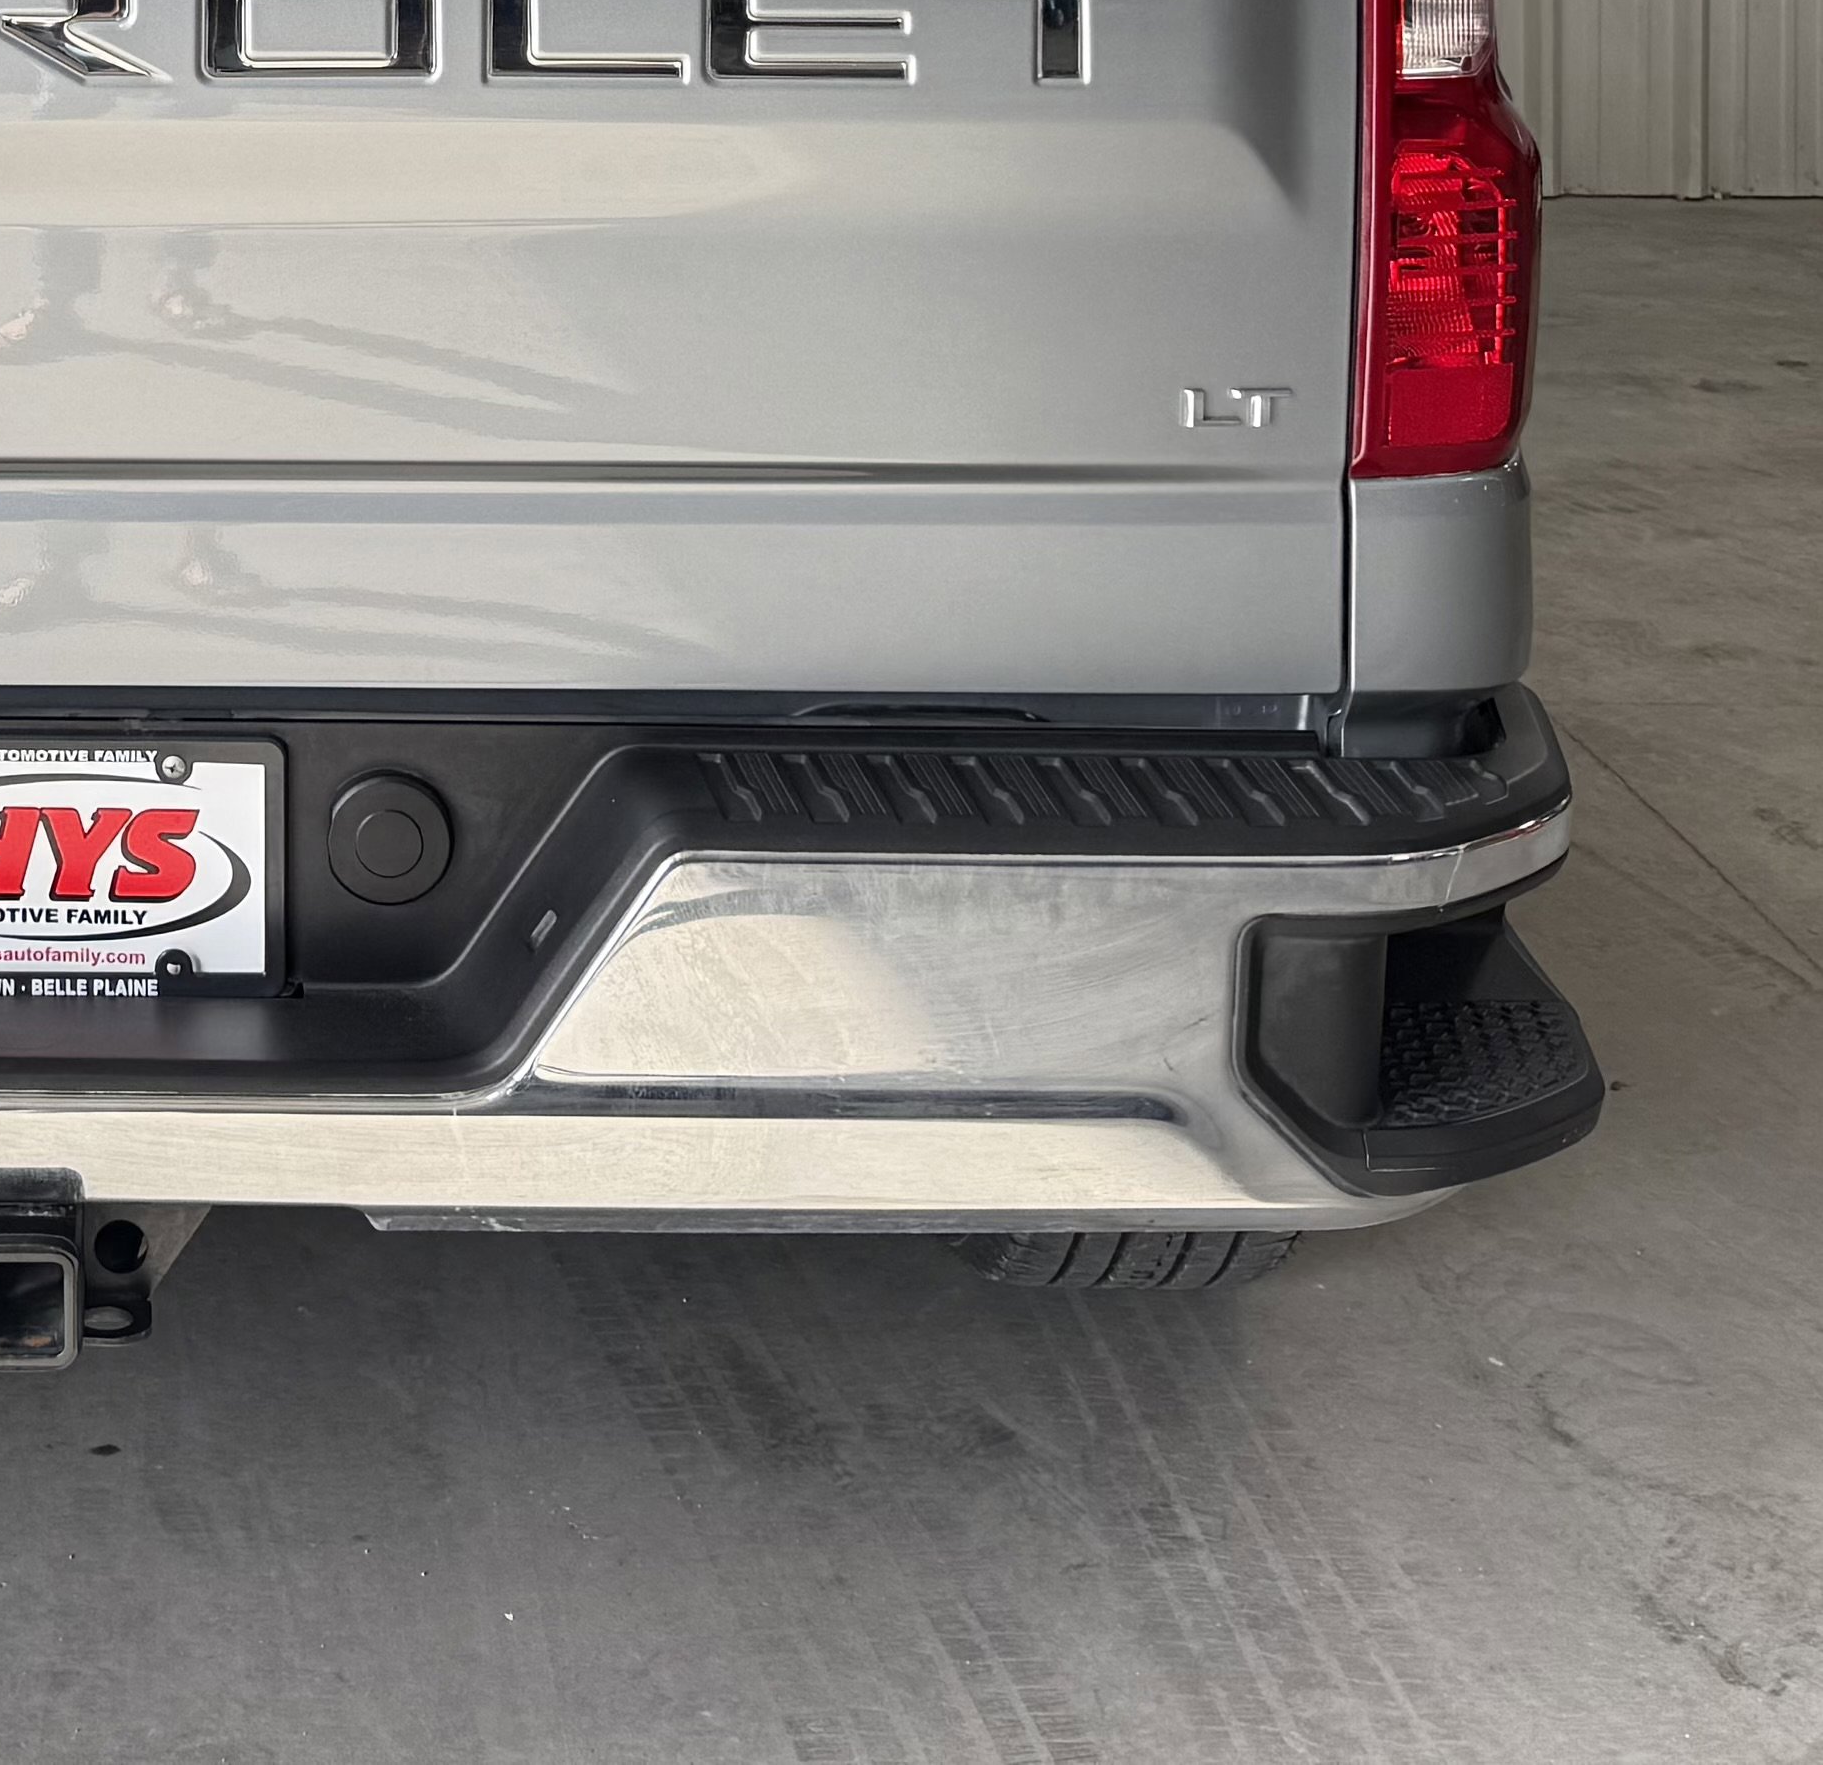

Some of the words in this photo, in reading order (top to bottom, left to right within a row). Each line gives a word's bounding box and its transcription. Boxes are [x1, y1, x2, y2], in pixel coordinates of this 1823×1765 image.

[1178, 387, 1293, 428] LT
[94, 748, 158, 763] FAMILY
[66, 908, 148, 925] FAMILY
[31, 979, 88, 996] BELLE
[93, 979, 159, 997] PLAINE
